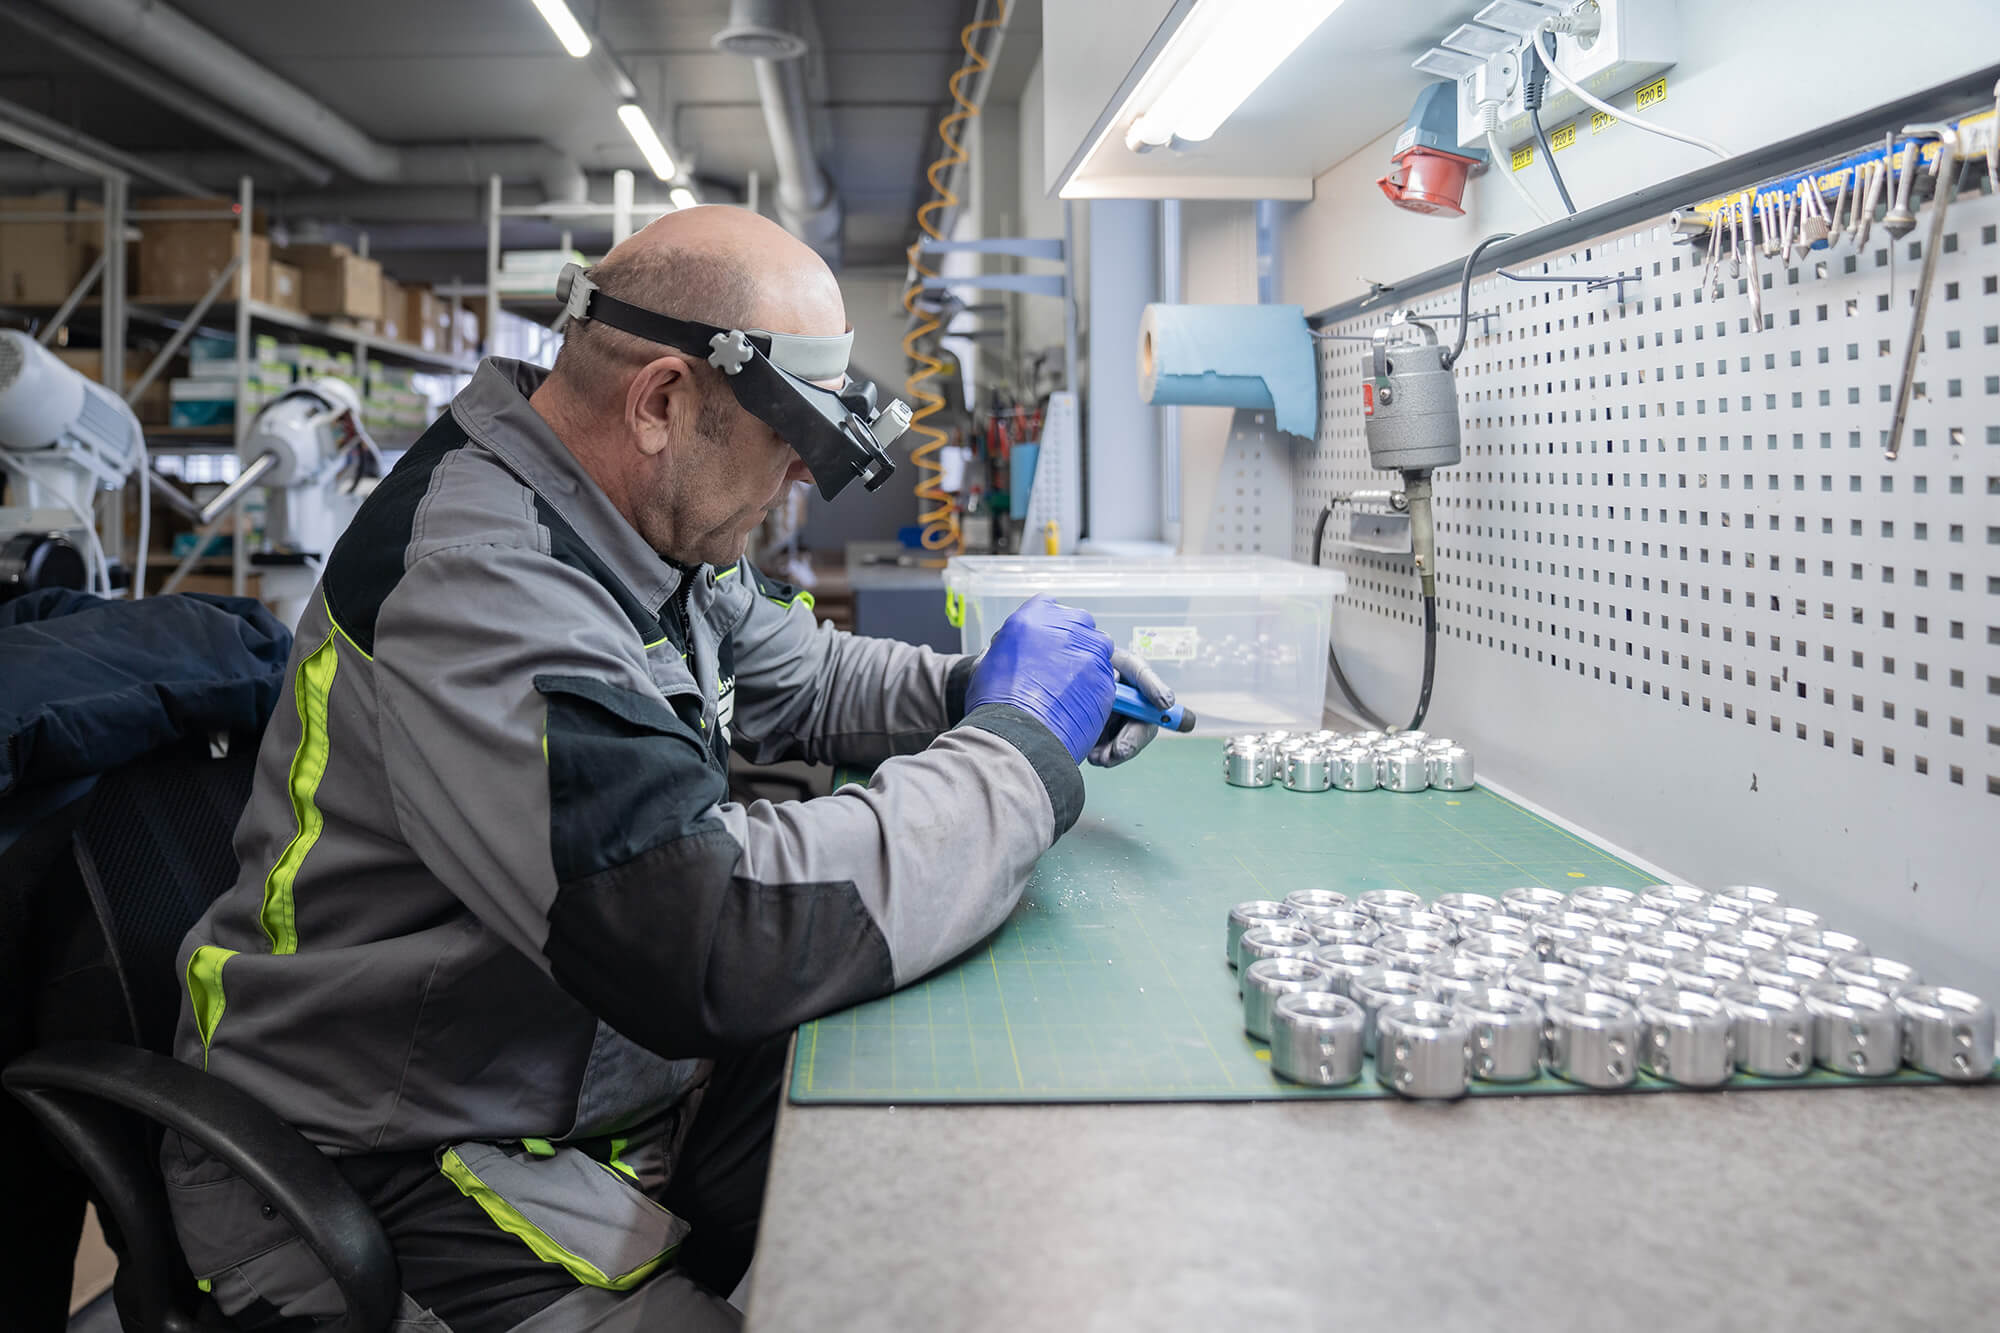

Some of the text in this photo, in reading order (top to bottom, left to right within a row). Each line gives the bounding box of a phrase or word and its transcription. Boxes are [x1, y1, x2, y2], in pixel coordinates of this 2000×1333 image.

[1639, 88, 1656, 106] 220
[1554, 132, 1567, 147] 220
[1514, 153, 1526, 166] 220
